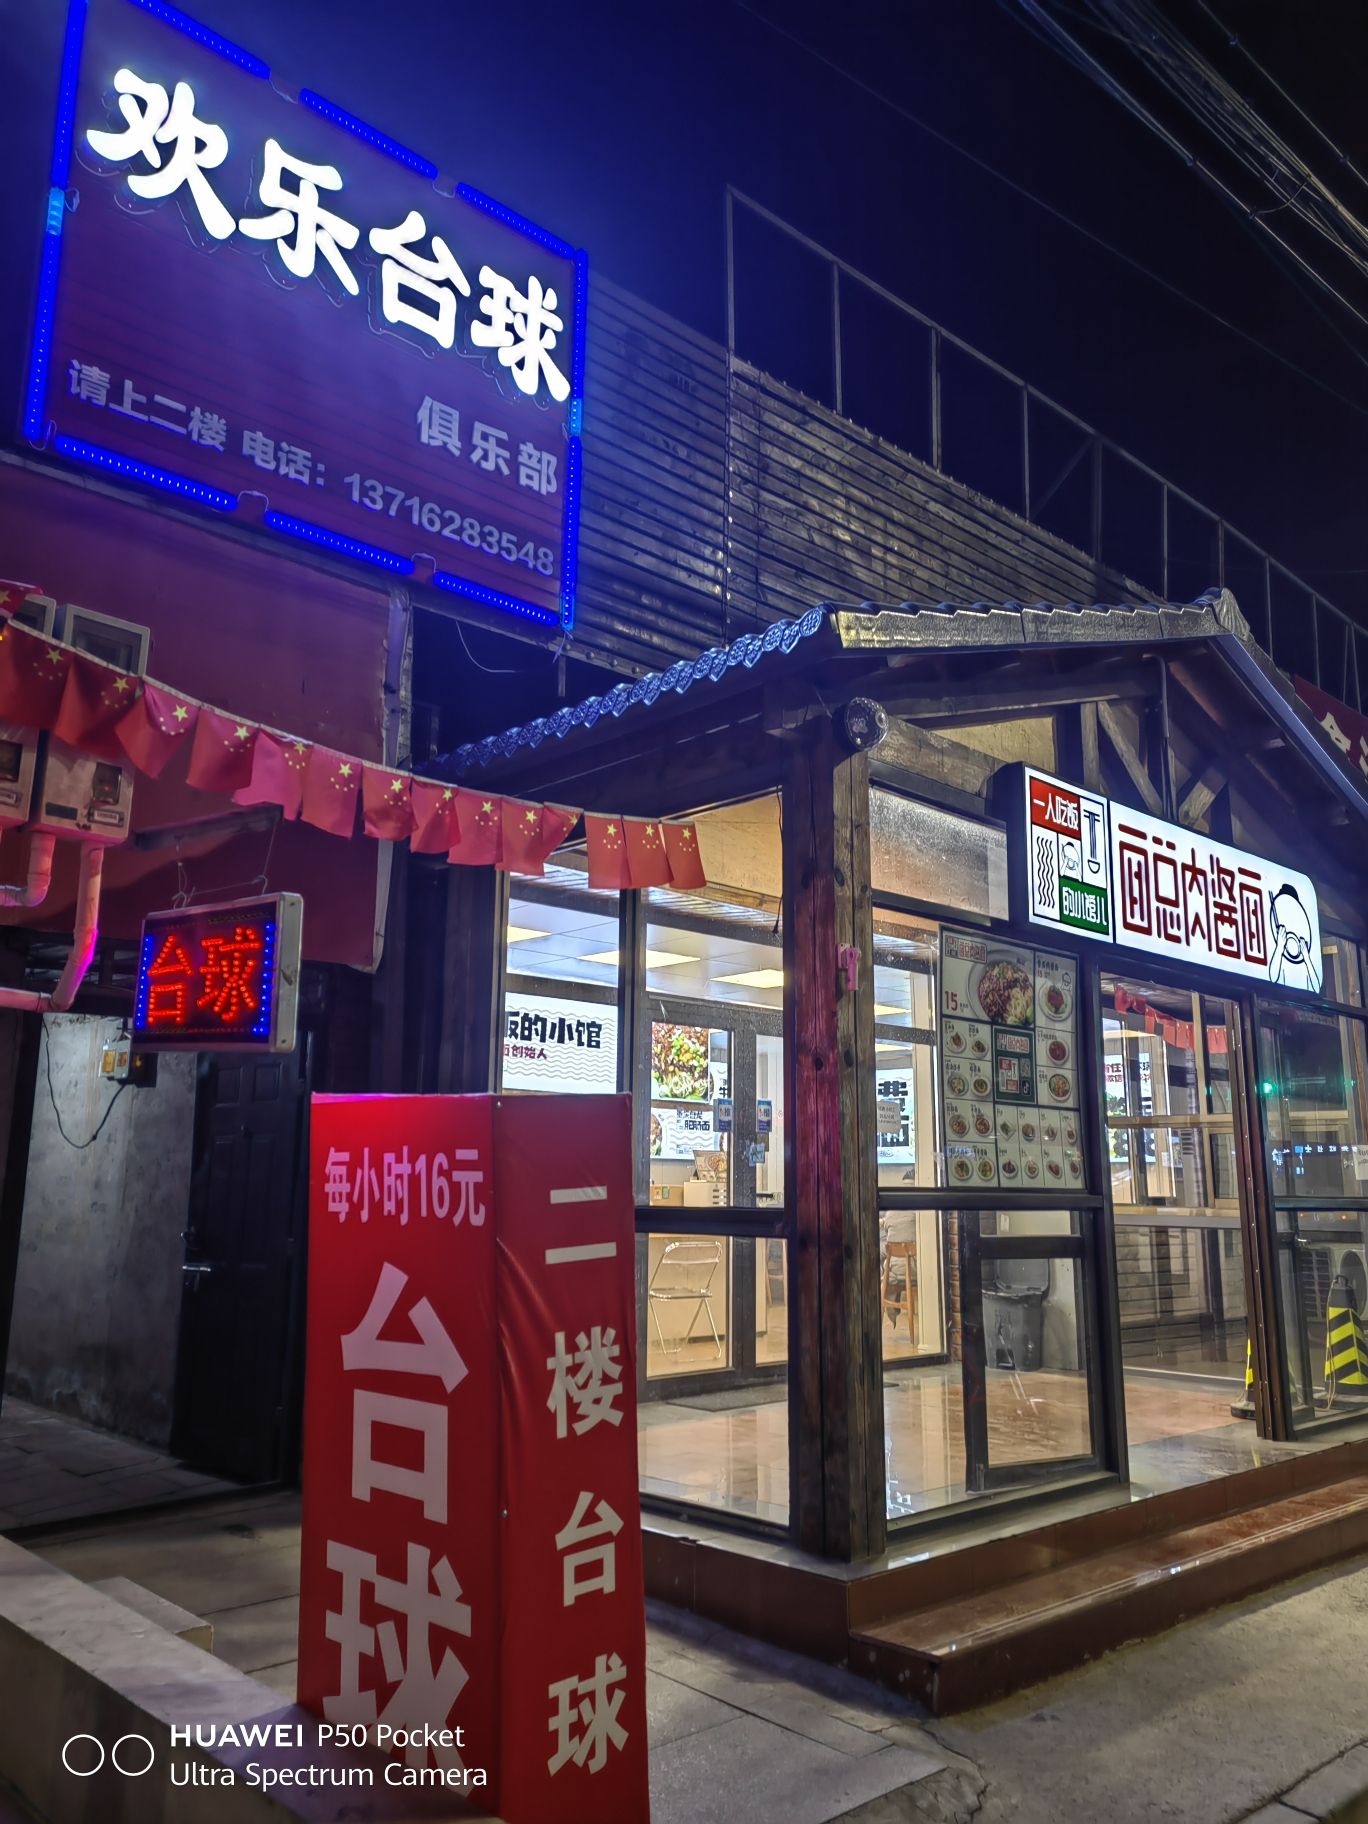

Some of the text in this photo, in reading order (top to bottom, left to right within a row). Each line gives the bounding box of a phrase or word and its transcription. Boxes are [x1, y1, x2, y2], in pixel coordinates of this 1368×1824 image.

[87, 69, 570, 402] 欢乐台球
[68, 359, 227, 452] 请上二楼
[344, 472, 554, 577] 13716283548
[416, 395, 558, 496] 俱乐部
[1033, 793, 1079, 831] 一人吃饭
[1062, 886, 1108, 926] 的小馆儿
[1117, 823, 1268, 967] 面总肉酱面
[147, 926, 262, 1024] 台球
[944, 991, 958, 1011] 15
[324, 1145, 487, 1228] 每小时16元
[321, 1261, 472, 1799] 台球
